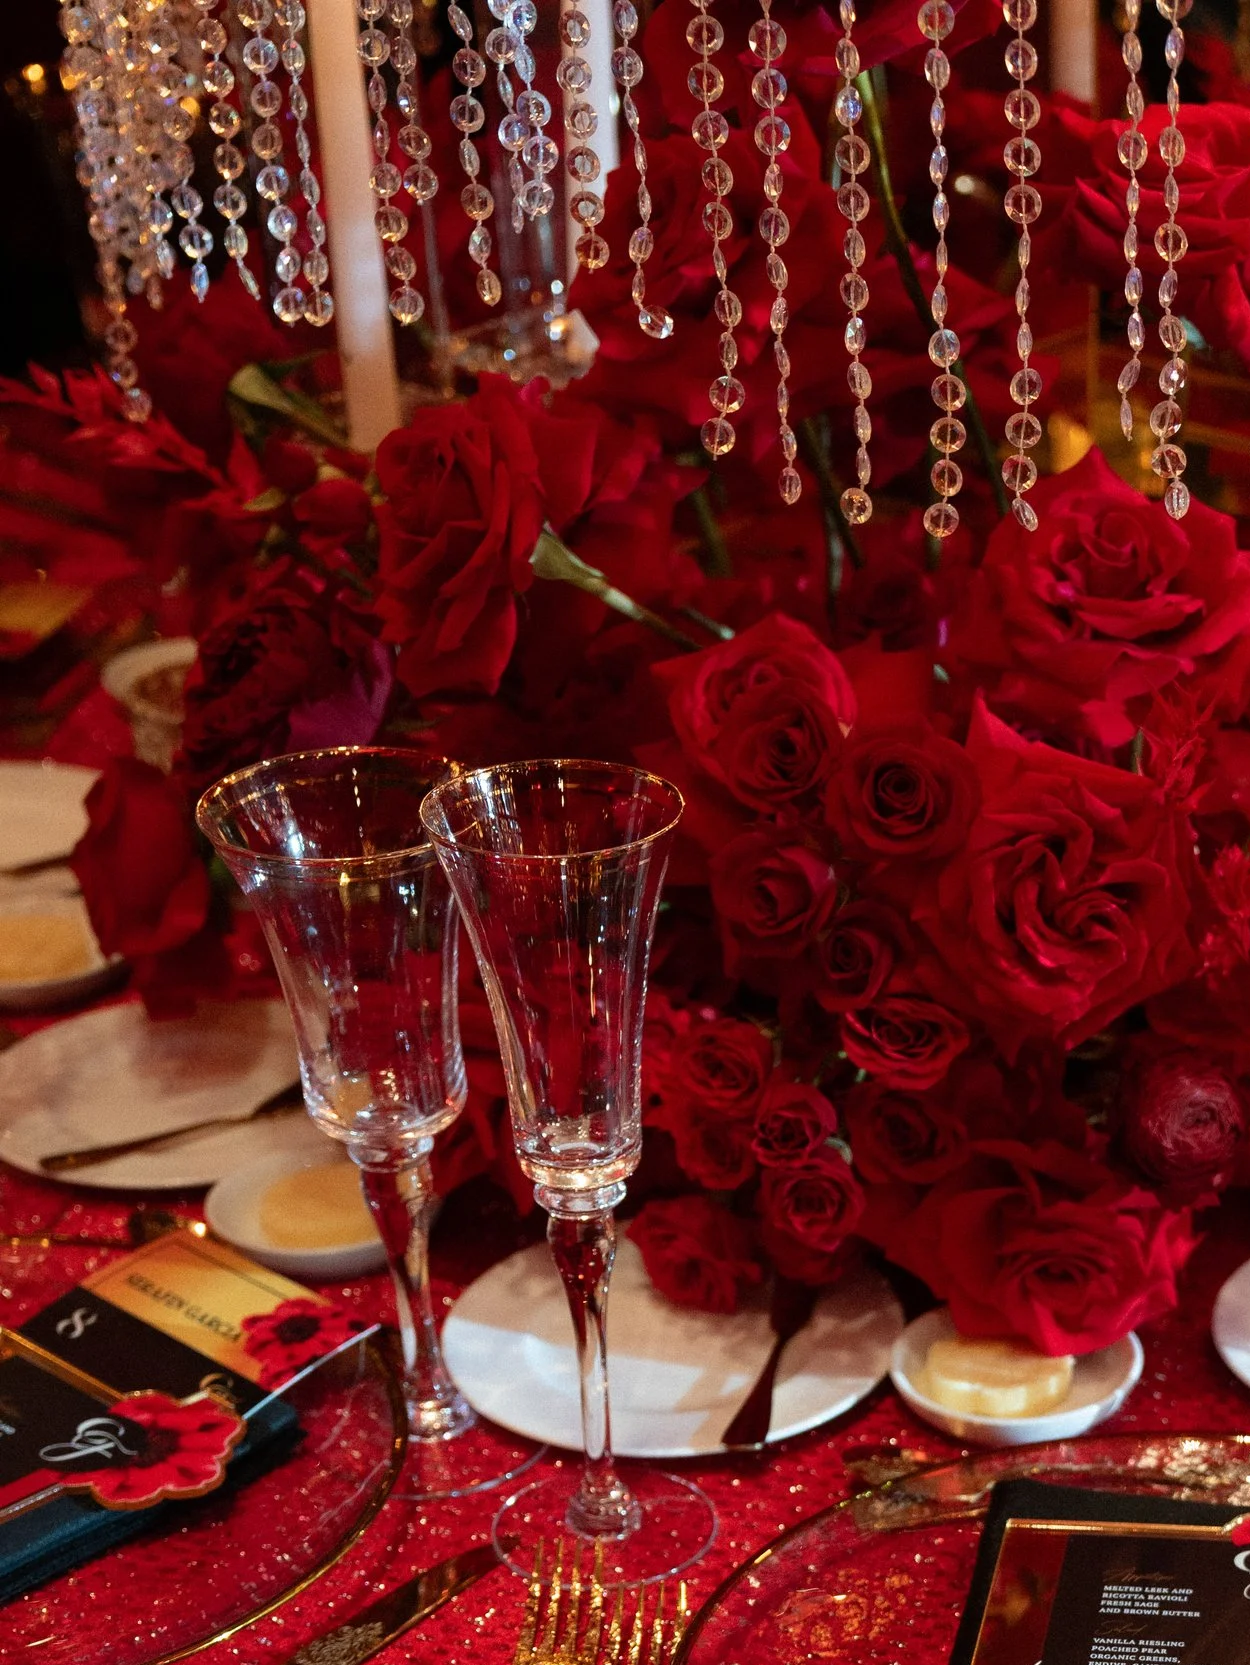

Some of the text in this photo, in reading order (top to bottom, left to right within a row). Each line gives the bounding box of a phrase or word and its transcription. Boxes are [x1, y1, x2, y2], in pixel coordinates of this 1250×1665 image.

[55, 1306, 98, 1340] 8
[1102, 1592, 1188, 1602] RICOTTA RAVIOLI
[1123, 1608, 1160, 1616] BROWN
[1162, 1610, 1201, 1618] BUTTER
[1092, 1637, 1185, 1648] VANILLA RIESLING
[1091, 1645, 1139, 1653] POACHED
[1090, 1653, 1181, 1664] ORGANIC GREENS,
